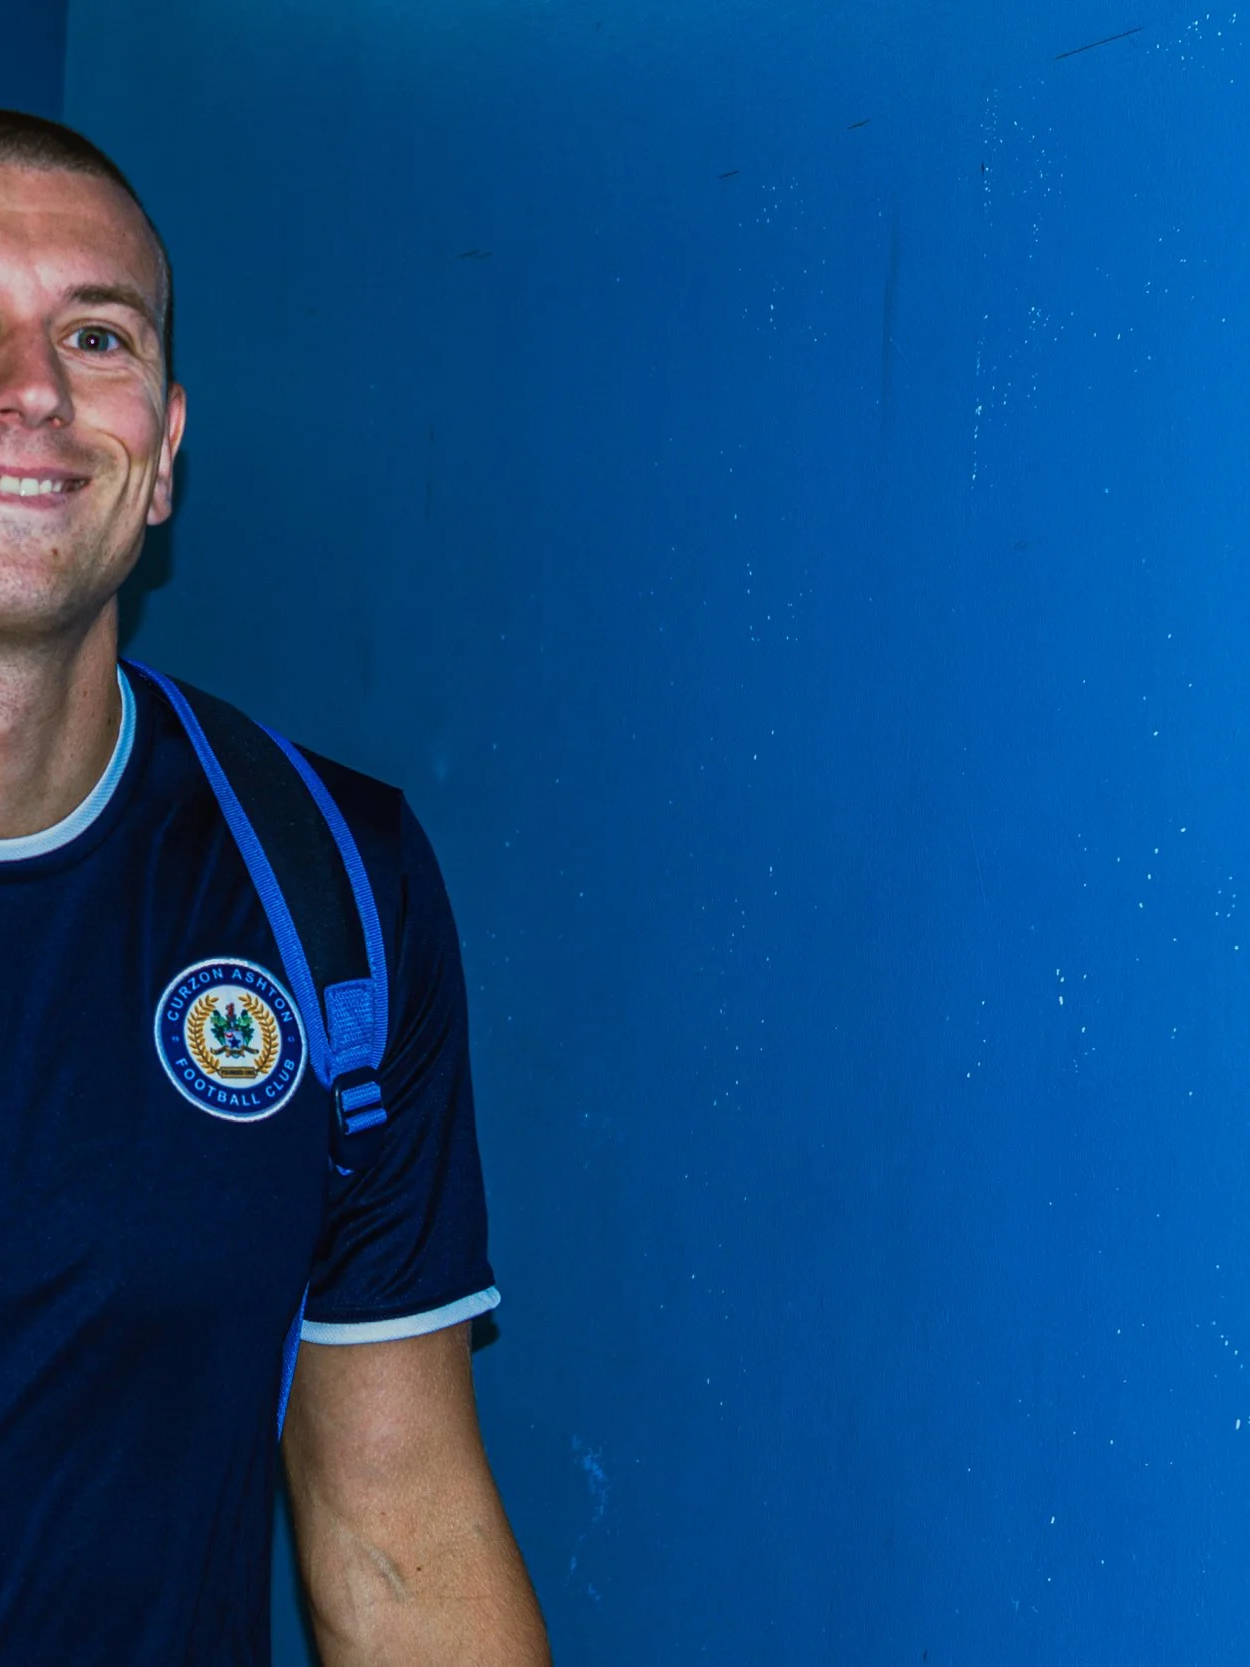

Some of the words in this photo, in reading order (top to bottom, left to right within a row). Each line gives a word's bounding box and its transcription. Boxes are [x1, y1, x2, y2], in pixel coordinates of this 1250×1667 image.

[167, 967, 223, 1021] CURZON
[232, 968, 293, 1023] ASHTON
[175, 1057, 261, 1107] FOOTBALL
[265, 1058, 295, 1098] CLUB
